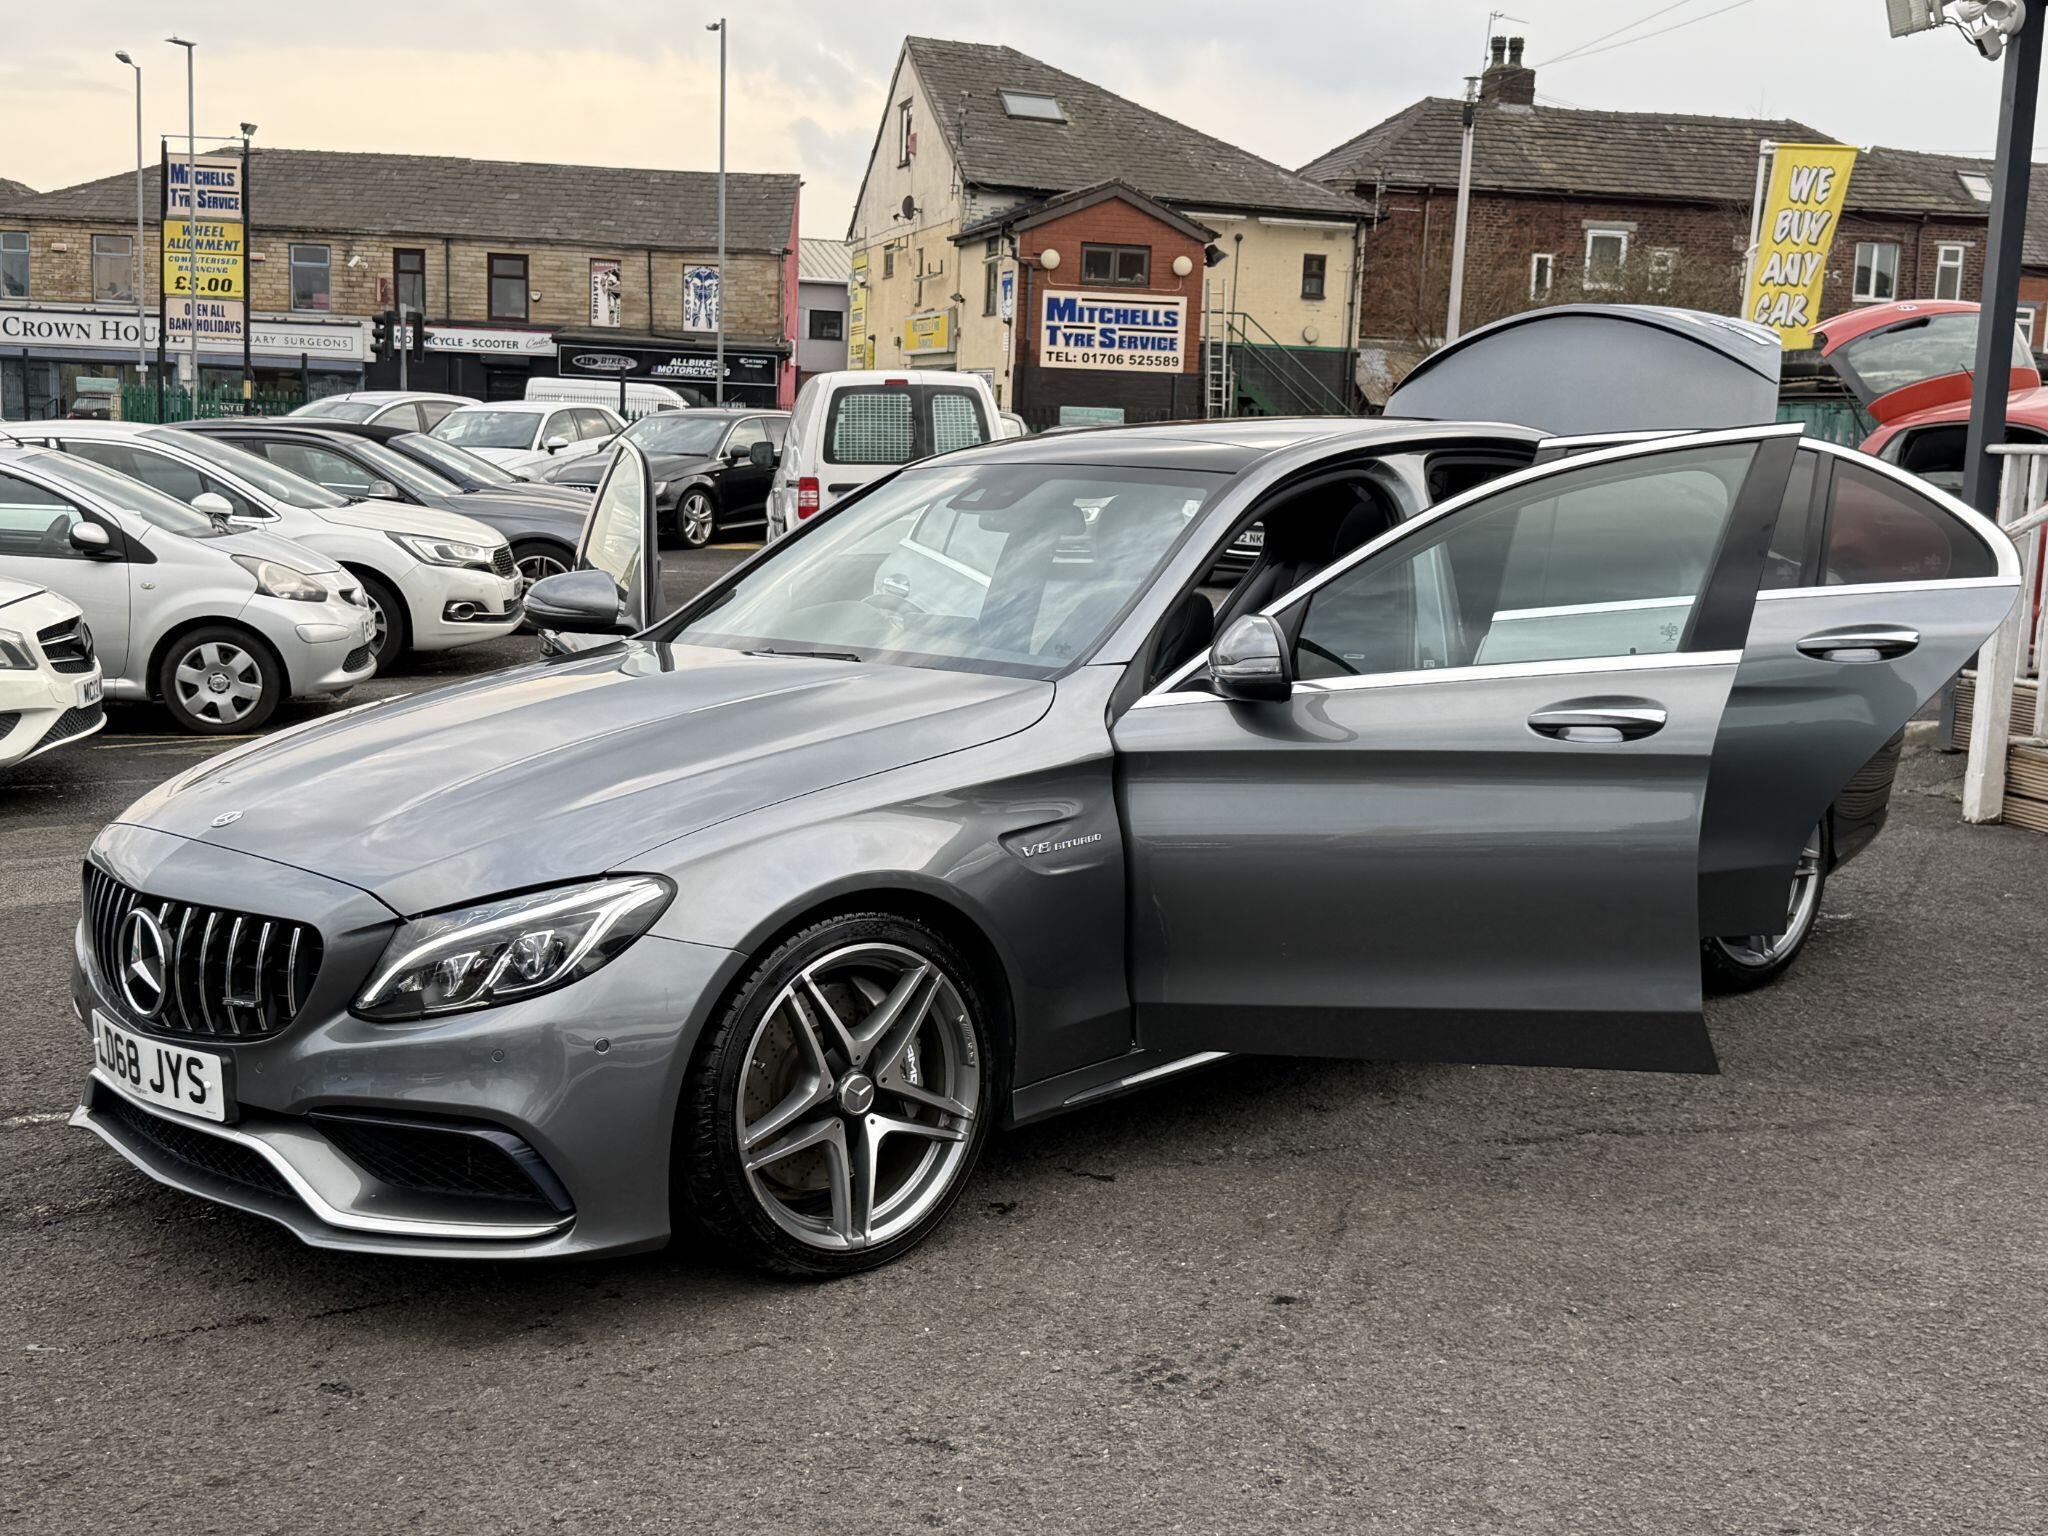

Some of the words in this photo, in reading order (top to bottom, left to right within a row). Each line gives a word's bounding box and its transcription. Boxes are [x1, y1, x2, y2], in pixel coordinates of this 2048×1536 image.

[170, 163, 235, 187] MICHELLS
[1789, 165, 1835, 204] WE
[170, 188, 190, 207] TYR
[197, 190, 239, 210] SERVICE
[182, 225, 225, 237] WHEEL
[1772, 208, 1832, 246] BUY
[1759, 251, 1823, 287] ANY
[174, 276, 233, 293] £5.00
[184, 303, 208, 316] OEN
[210, 305, 226, 318] ALL
[1046, 298, 1178, 327] MITCHELLS
[1754, 293, 1810, 328] CAR
[2, 316, 91, 339] CROWN
[196, 319, 241, 334] HOLIDAYS
[284, 336, 348, 348] SURGEONS
[472, 339, 519, 350] SCOOTER
[1046, 326, 1095, 348] TYRE
[1098, 327, 1177, 351] SERVICE
[601, 356, 630, 366] BIKES
[1046, 351, 1077, 362] TEL:
[1081, 353, 1124, 365] 01706
[1128, 355, 1179, 367] 525589
[656, 365, 730, 377] MOTORCYCLS
[1054, 834, 1102, 850] BITURBO
[96, 1017, 141, 1086] LD68
[150, 1048, 207, 1105] JYS
